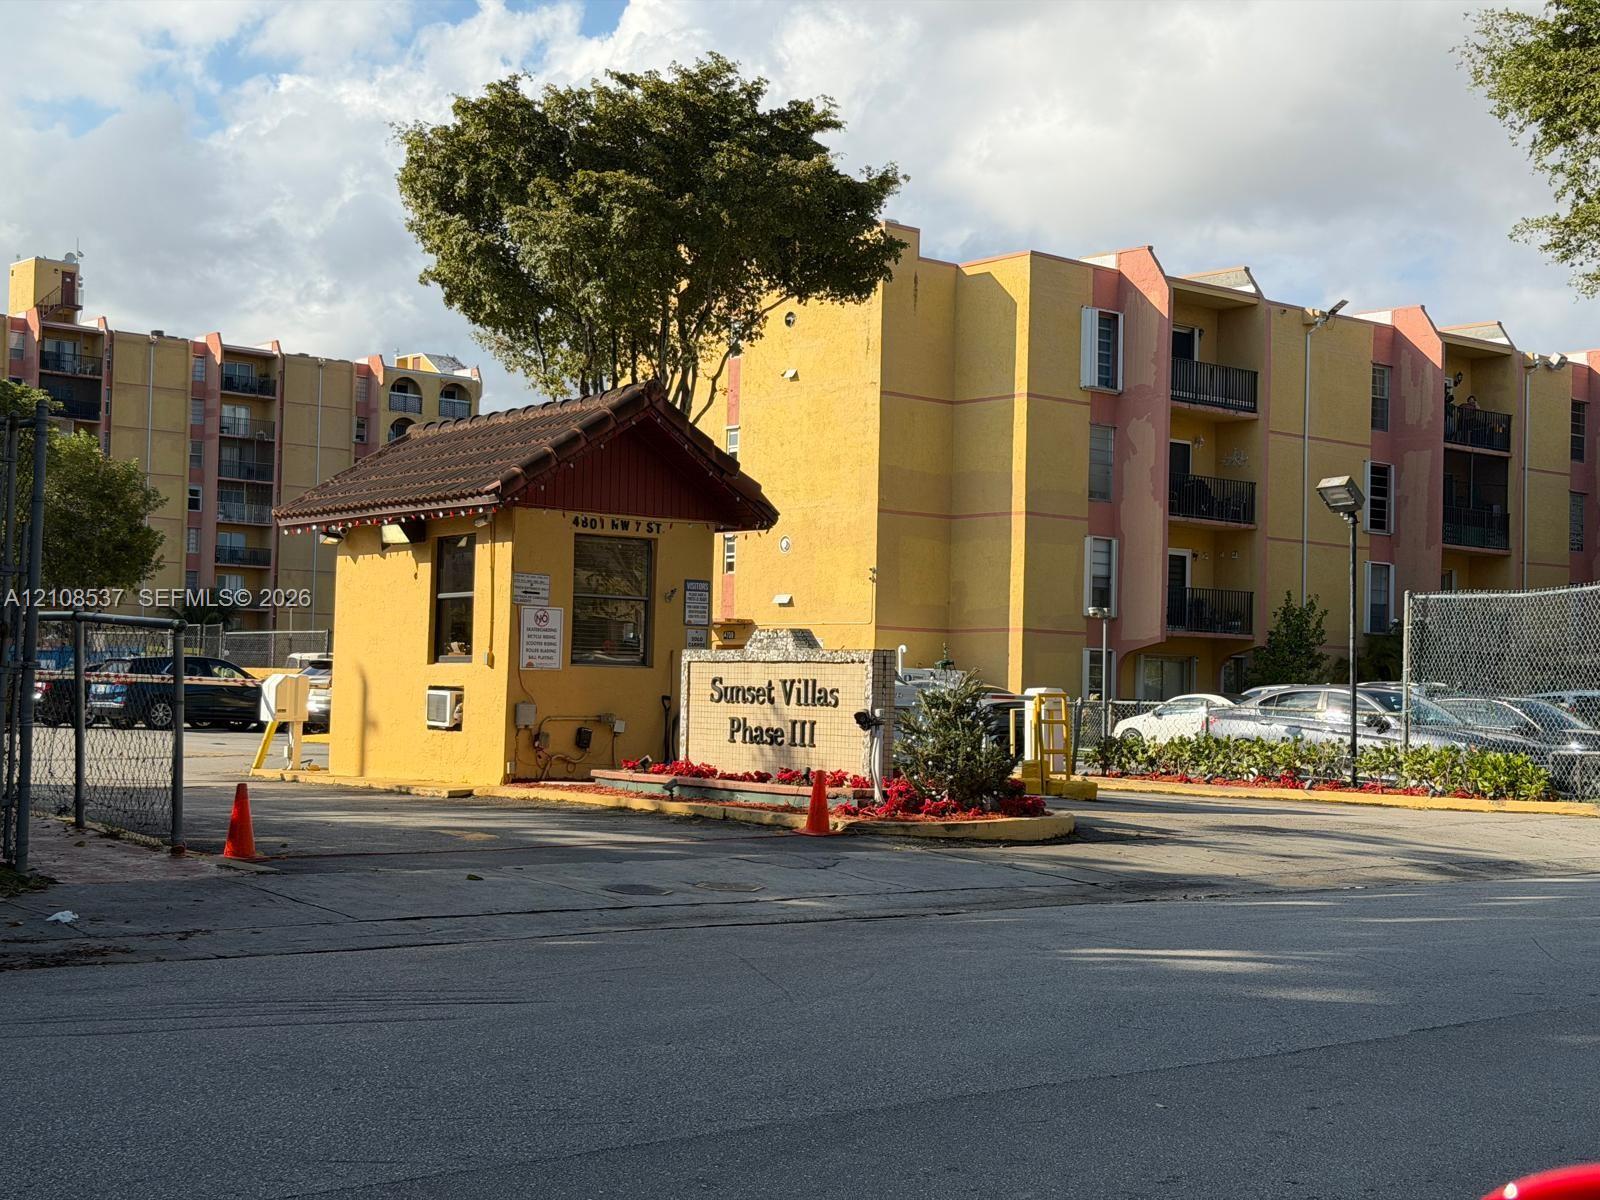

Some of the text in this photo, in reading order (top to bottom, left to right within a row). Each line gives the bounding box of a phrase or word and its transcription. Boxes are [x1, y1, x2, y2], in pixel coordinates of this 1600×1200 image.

[611, 519, 630, 531] NW
[646, 521, 662, 534] ST
[686, 582, 709, 591] VISITORS
[709, 676, 840, 708] Sunset Villas
[727, 716, 817, 748] Phase III
